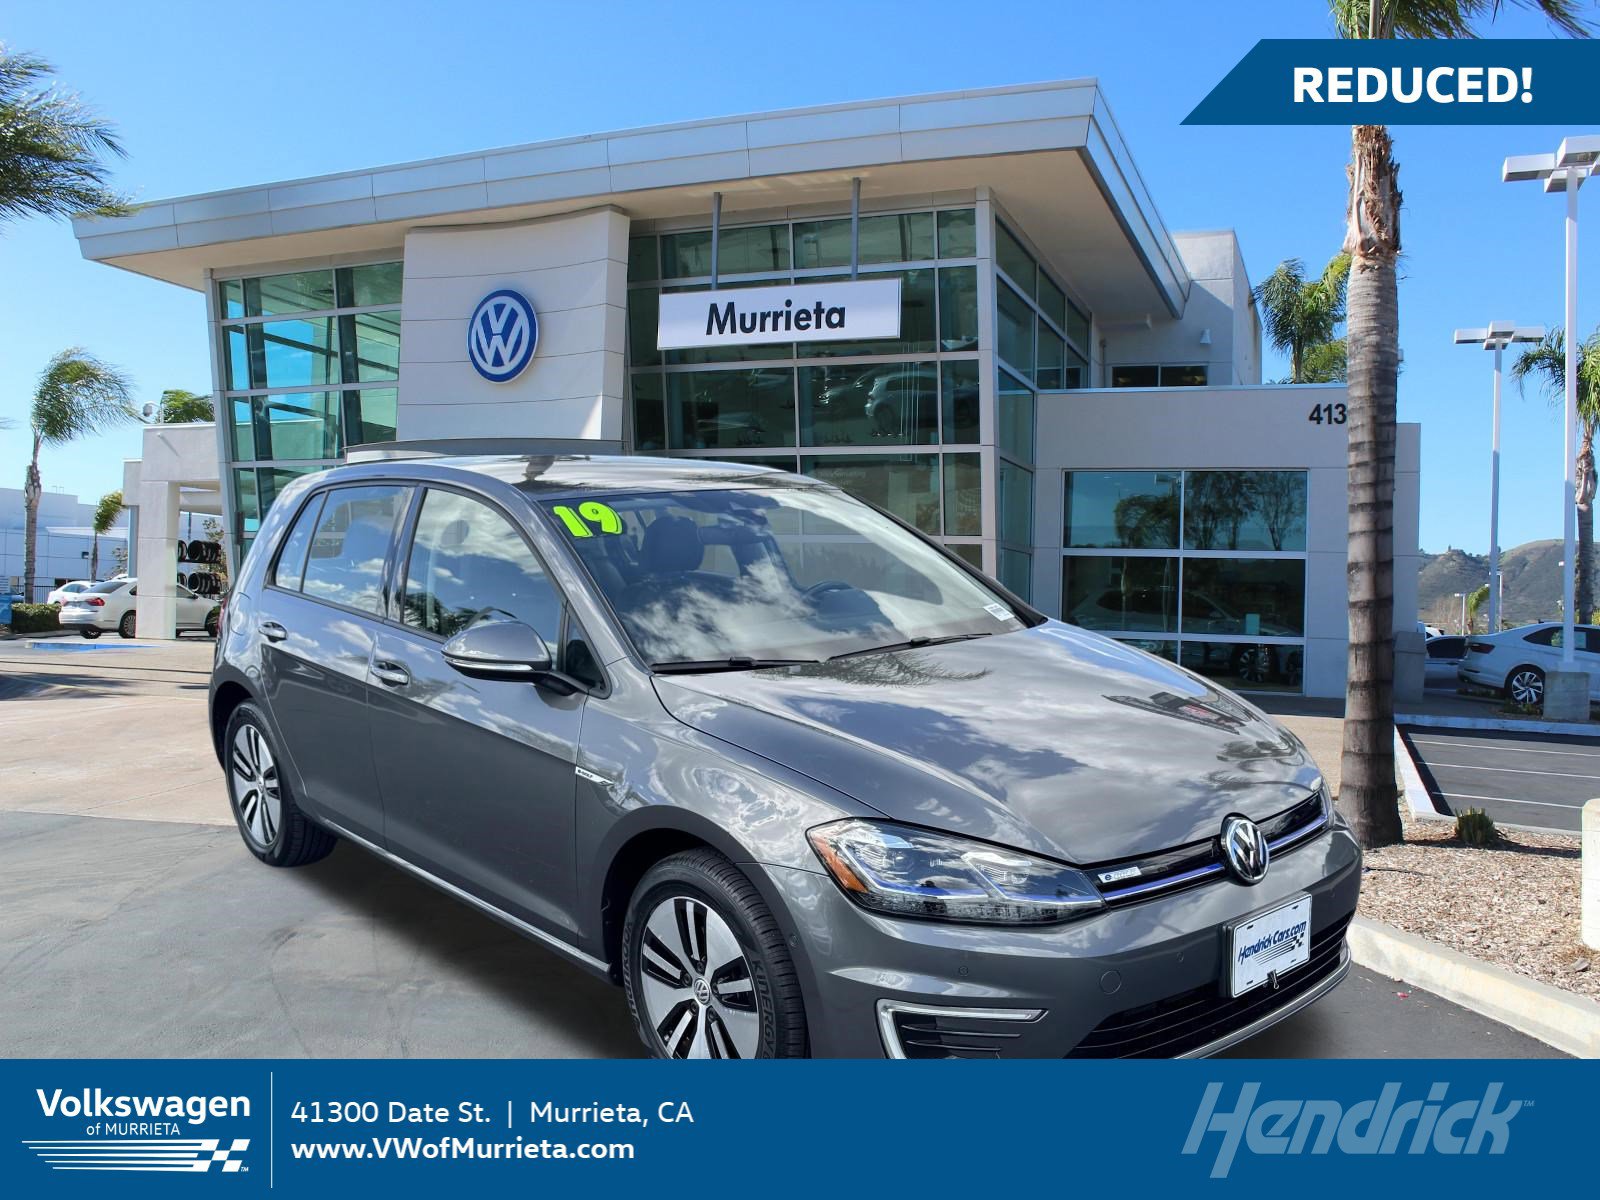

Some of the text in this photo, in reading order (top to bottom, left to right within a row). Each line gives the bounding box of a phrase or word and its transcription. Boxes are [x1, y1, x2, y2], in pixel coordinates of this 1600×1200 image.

[706, 299, 846, 336] Murrieta
[1308, 403, 1347, 425] 413
[552, 501, 622, 538] 19
